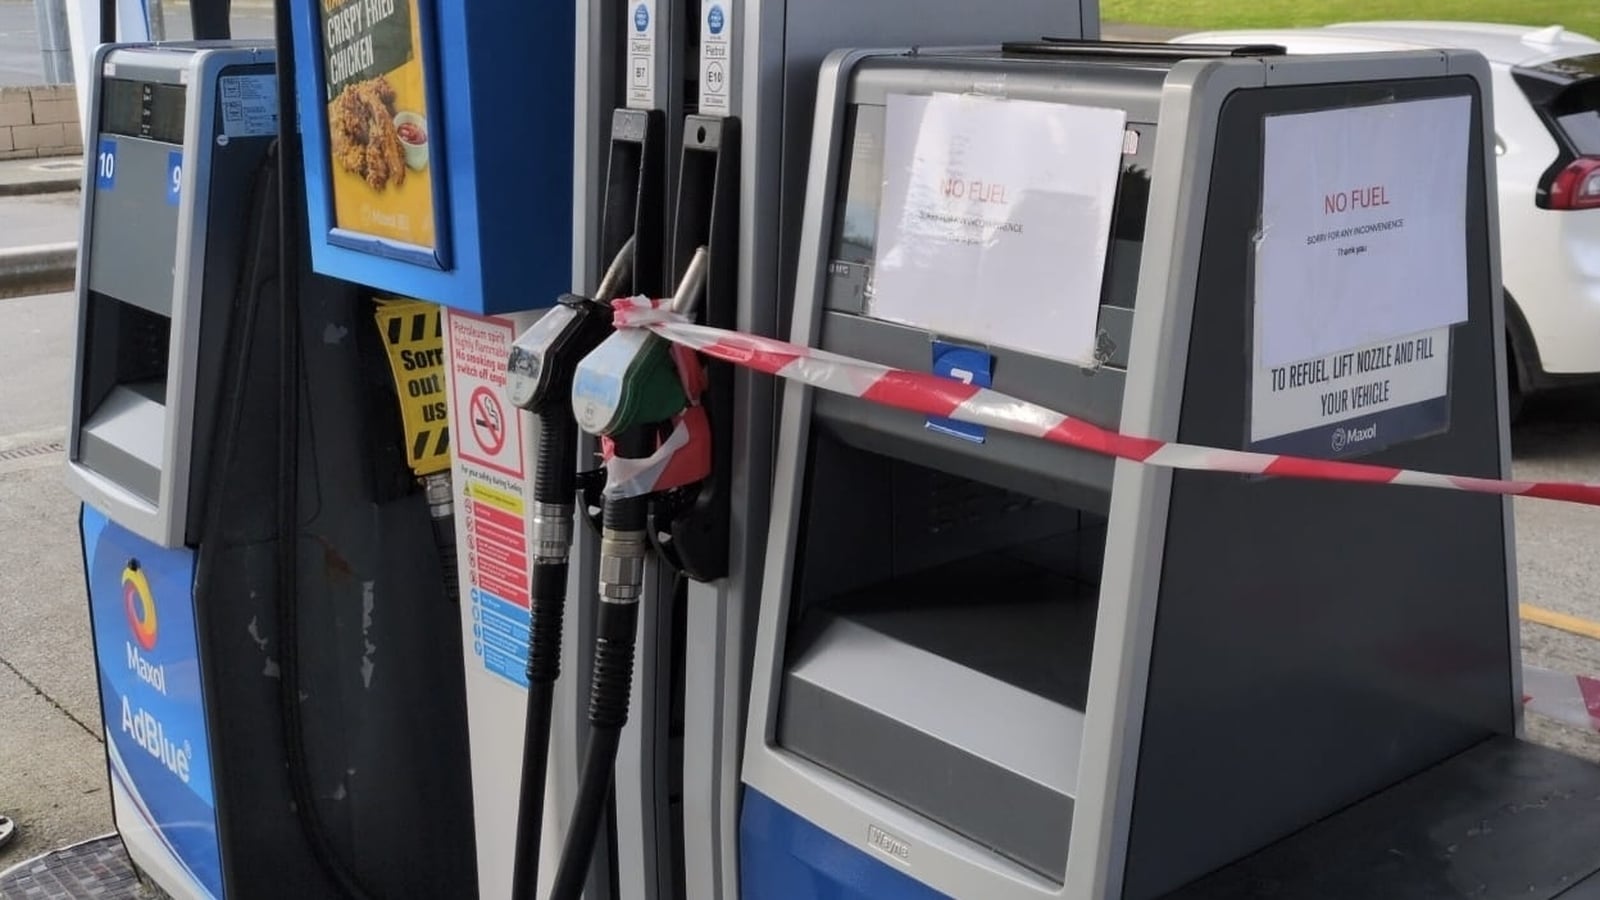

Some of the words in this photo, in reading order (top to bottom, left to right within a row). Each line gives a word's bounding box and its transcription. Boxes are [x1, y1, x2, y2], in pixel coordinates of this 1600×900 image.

[327, 1, 362, 48] CRISPY
[364, 0, 394, 27] FRIED
[330, 33, 374, 85] CHICKEN
[708, 71, 723, 83] E10
[99, 152, 114, 179] 10
[172, 165, 182, 193] 9
[941, 178, 965, 198] NO
[968, 181, 1008, 204] FUEL
[1325, 192, 1348, 215] NO
[1351, 186, 1390, 210] FUEL
[1327, 230, 1340, 240] FOR
[1340, 227, 1354, 238] ANY
[1353, 218, 1405, 235] INCONVENIENCE
[1337, 246, 1355, 256] Thank
[1356, 245, 1367, 256] you
[453, 320, 487, 339] Petroleum
[401, 347, 443, 371] Sorr
[455, 348, 466, 361] No
[466, 353, 496, 372] smoking
[497, 362, 506, 371] an
[1272, 368, 1286, 392] TO
[1289, 359, 1330, 388] REFUEL,
[1333, 353, 1355, 380] LIFT
[1357, 345, 1392, 374] NOZZLE
[1394, 341, 1413, 366] AND
[1416, 336, 1434, 361] FILL
[408, 373, 441, 397] out
[457, 363, 478, 377] switch
[479, 368, 488, 380] off
[489, 374, 507, 387] engi
[1320, 390, 1348, 416] YOUR
[1351, 379, 1390, 411] VEHICLE
[422, 402, 447, 423] us
[1347, 423, 1377, 444] Maxol
[127, 641, 167, 696] Maxol
